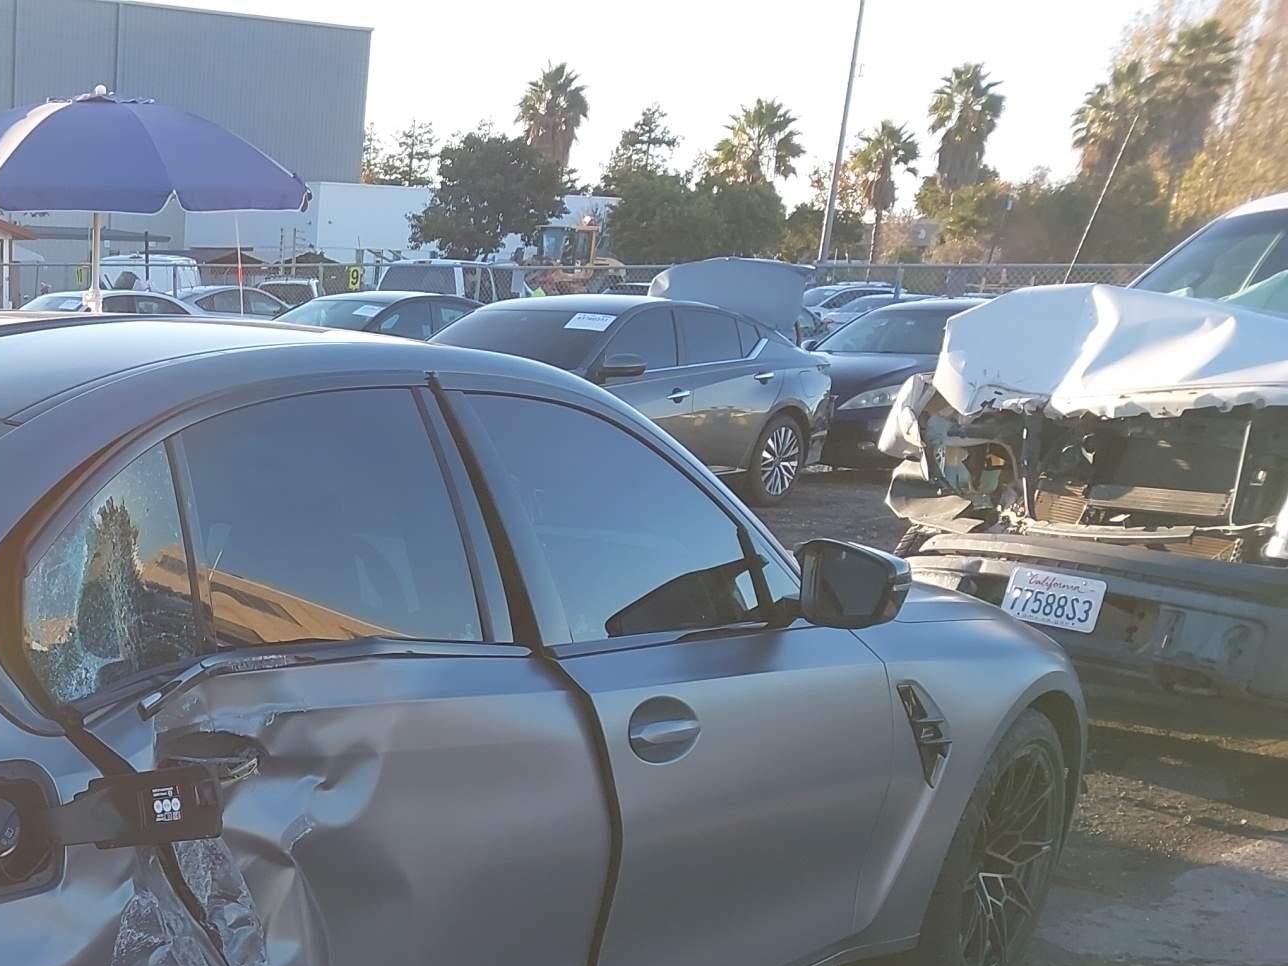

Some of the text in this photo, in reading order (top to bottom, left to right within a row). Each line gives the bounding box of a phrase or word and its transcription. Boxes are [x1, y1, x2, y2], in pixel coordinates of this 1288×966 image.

[351, 269, 359, 286] 9
[1028, 573, 1083, 593] California
[1010, 586, 1093, 623] 77588S3
